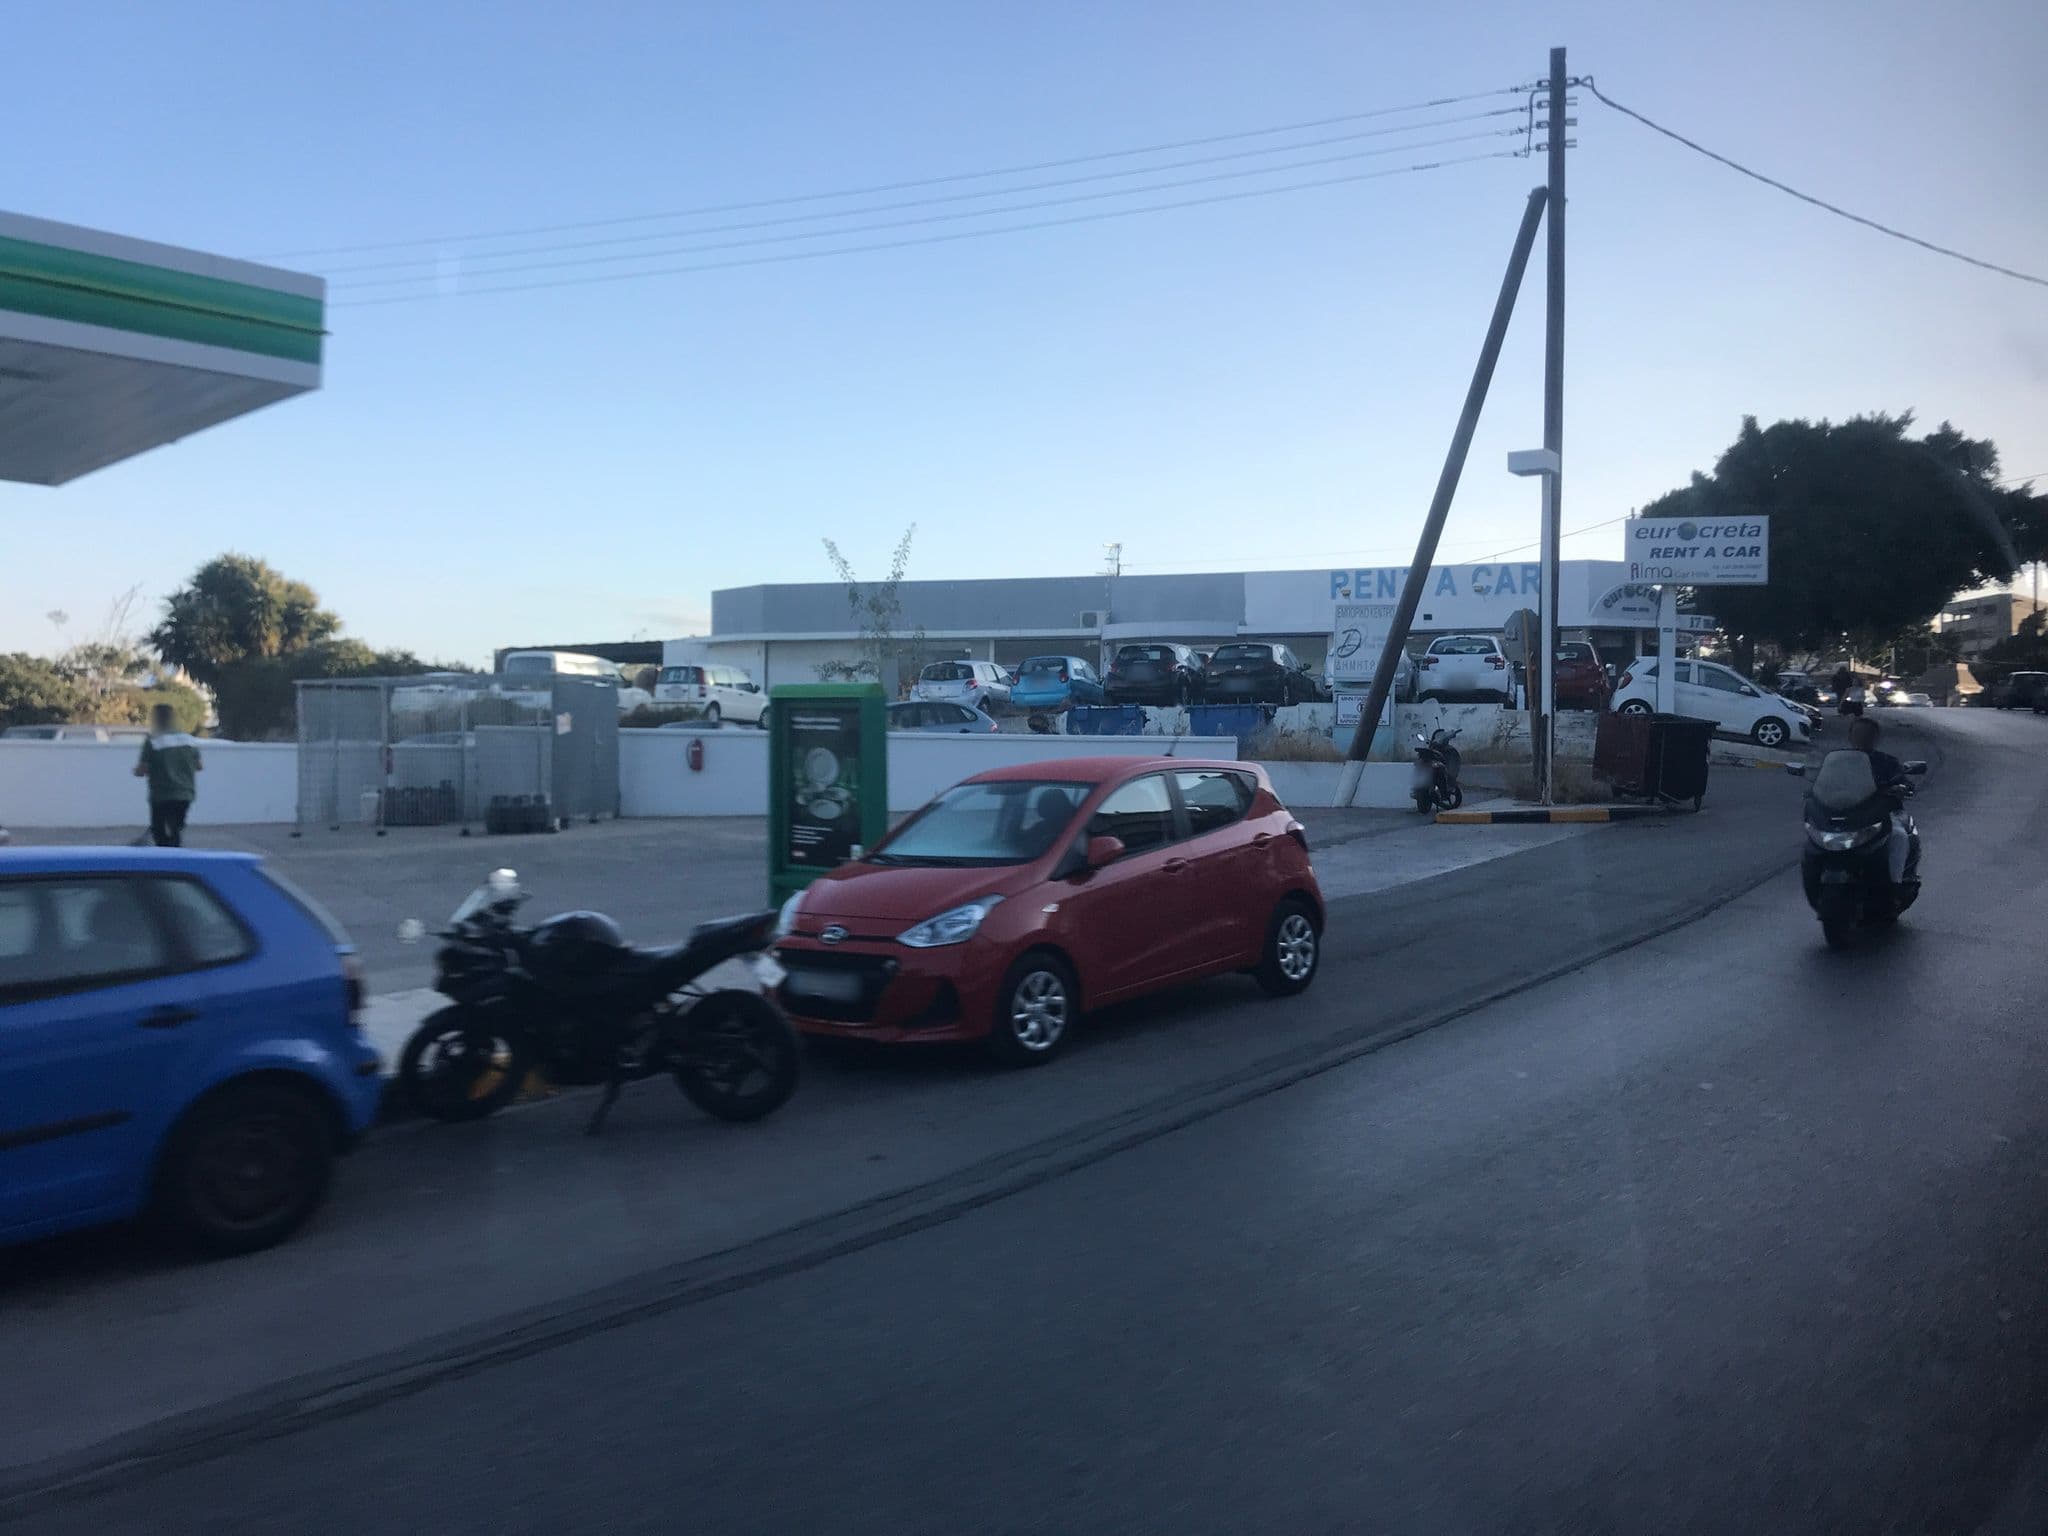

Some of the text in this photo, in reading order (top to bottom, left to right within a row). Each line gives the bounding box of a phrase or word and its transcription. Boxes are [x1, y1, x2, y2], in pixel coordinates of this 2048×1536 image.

[1649, 546, 1762, 559] RENT A CAR
[1630, 562, 1673, 581] Alma
[1330, 564, 1542, 600] REN A CAR
